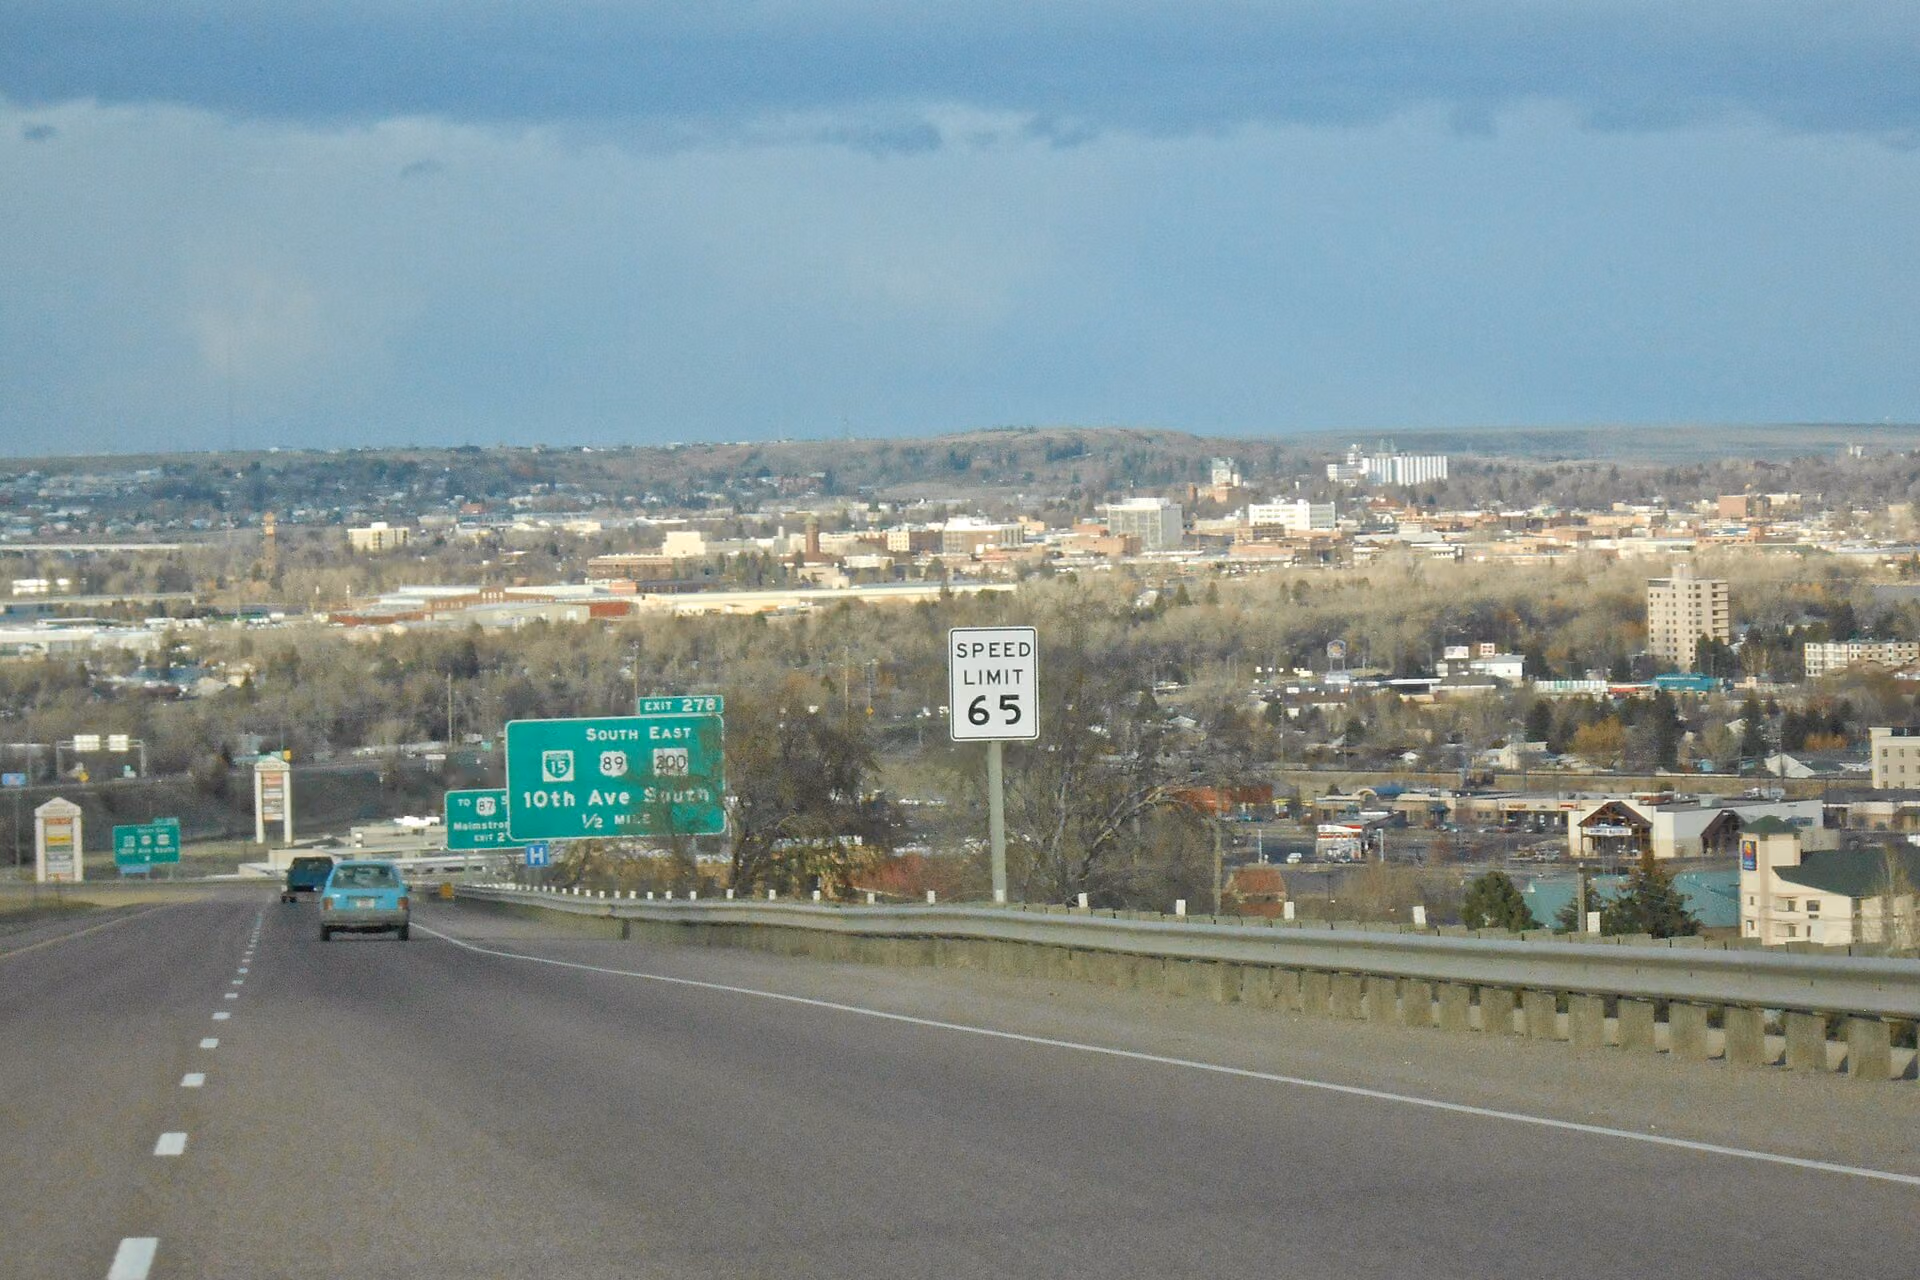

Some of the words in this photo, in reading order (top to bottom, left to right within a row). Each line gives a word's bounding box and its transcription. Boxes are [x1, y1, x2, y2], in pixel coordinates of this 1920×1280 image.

[956, 642, 1031, 658] SPEED
[963, 669, 1023, 685] LIMIT
[644, 701, 672, 711] EXIT
[682, 698, 716, 712] 278
[968, 694, 1021, 726] 65
[586, 728, 639, 741] SOUTH
[649, 726, 692, 739] EAST
[551, 760, 567, 774] 15
[602, 756, 624, 771] 89
[656, 754, 687, 770] 200
[457, 798, 471, 807] TO
[478, 800, 493, 811] 87
[523, 790, 575, 808] 10th
[588, 789, 631, 806] Ave
[529, 847, 545, 864] H
